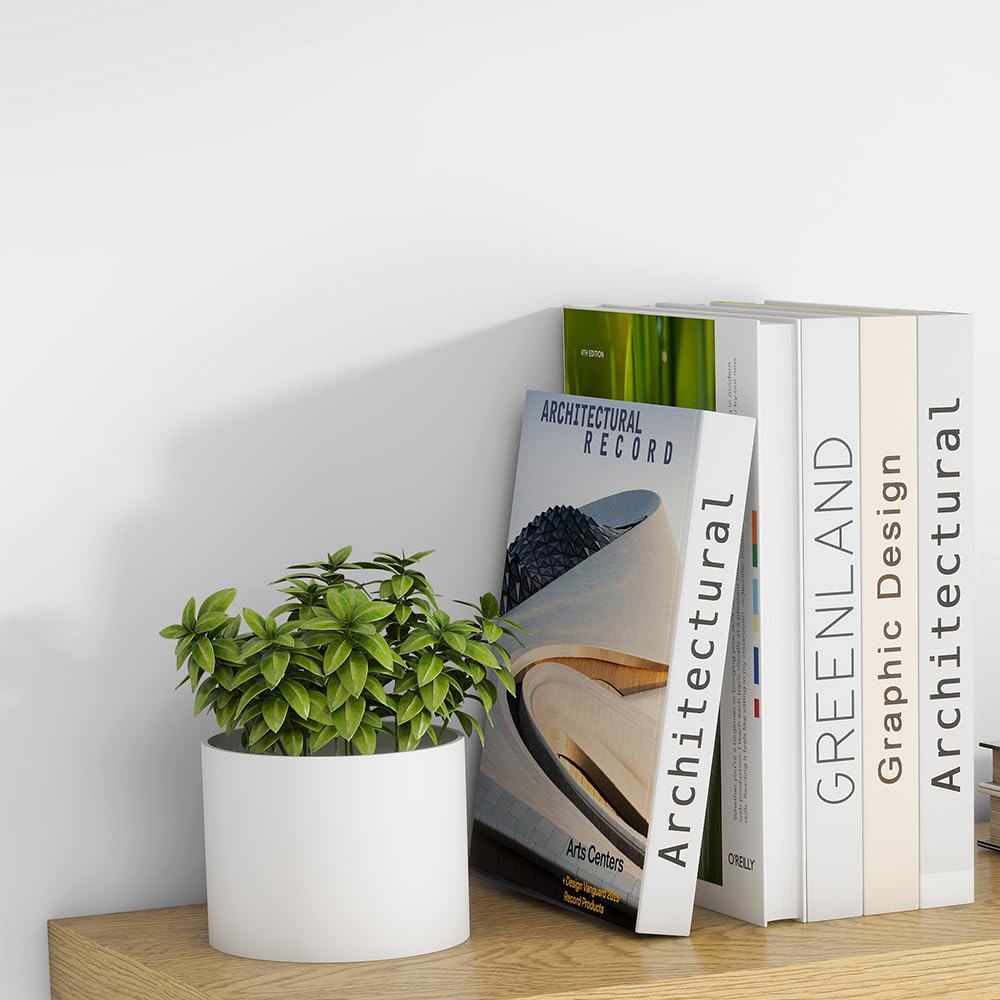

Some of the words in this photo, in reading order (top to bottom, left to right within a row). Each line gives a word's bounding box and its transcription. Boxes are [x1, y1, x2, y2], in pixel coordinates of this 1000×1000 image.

[541, 400, 642, 434] ARCHITECTURAL
[584, 431, 673, 465] RECORD
[876, 455, 908, 600] Design
[814, 437, 855, 805] GREENLAND
[929, 397, 961, 793] Architectural
[657, 493, 735, 868] Architectural
[877, 620, 908, 785] Graphic
[566, 838, 587, 860] Arts
[587, 845, 625, 872] Centers
[728, 852, 755, 870] O'REILLY
[563, 891, 582, 906] Record
[581, 896, 605, 914] Products
